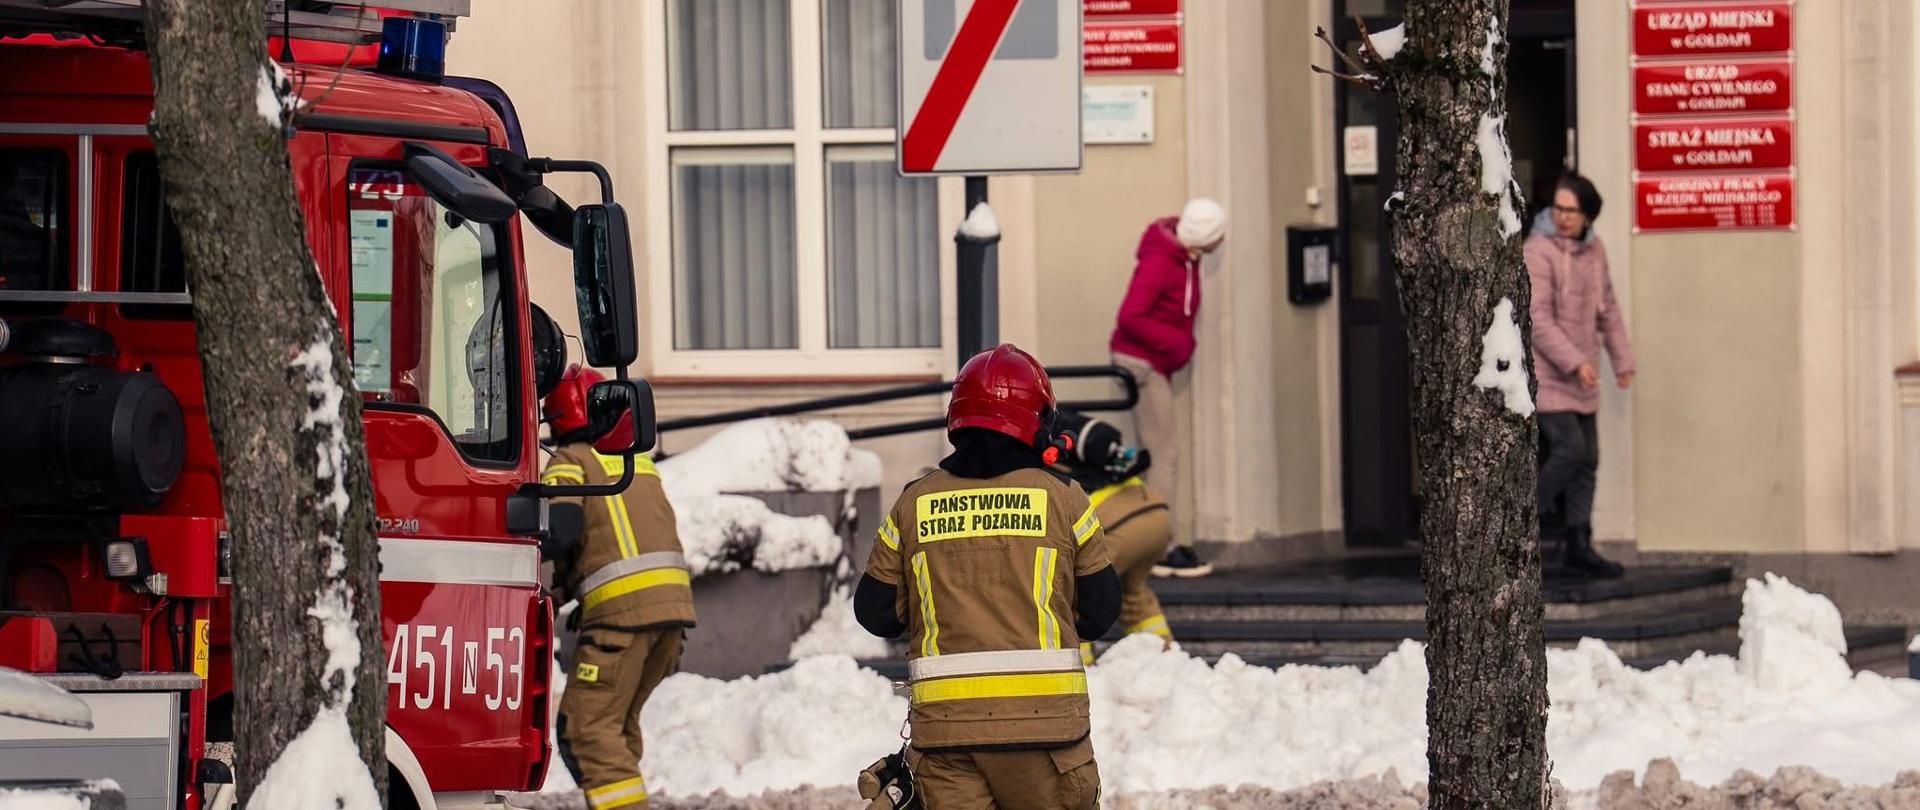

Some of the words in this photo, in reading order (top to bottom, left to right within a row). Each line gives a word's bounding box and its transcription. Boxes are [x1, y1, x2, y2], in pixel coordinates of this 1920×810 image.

[1709, 10, 1775, 29] MIEJSKI
[1648, 127, 1703, 148] STRAŻ
[1705, 128, 1776, 147] MIEJSKA
[930, 493, 1031, 515] PAŃSTWOWA
[387, 624, 454, 710] 451
[462, 641, 478, 694] N
[485, 626, 524, 711] 53
